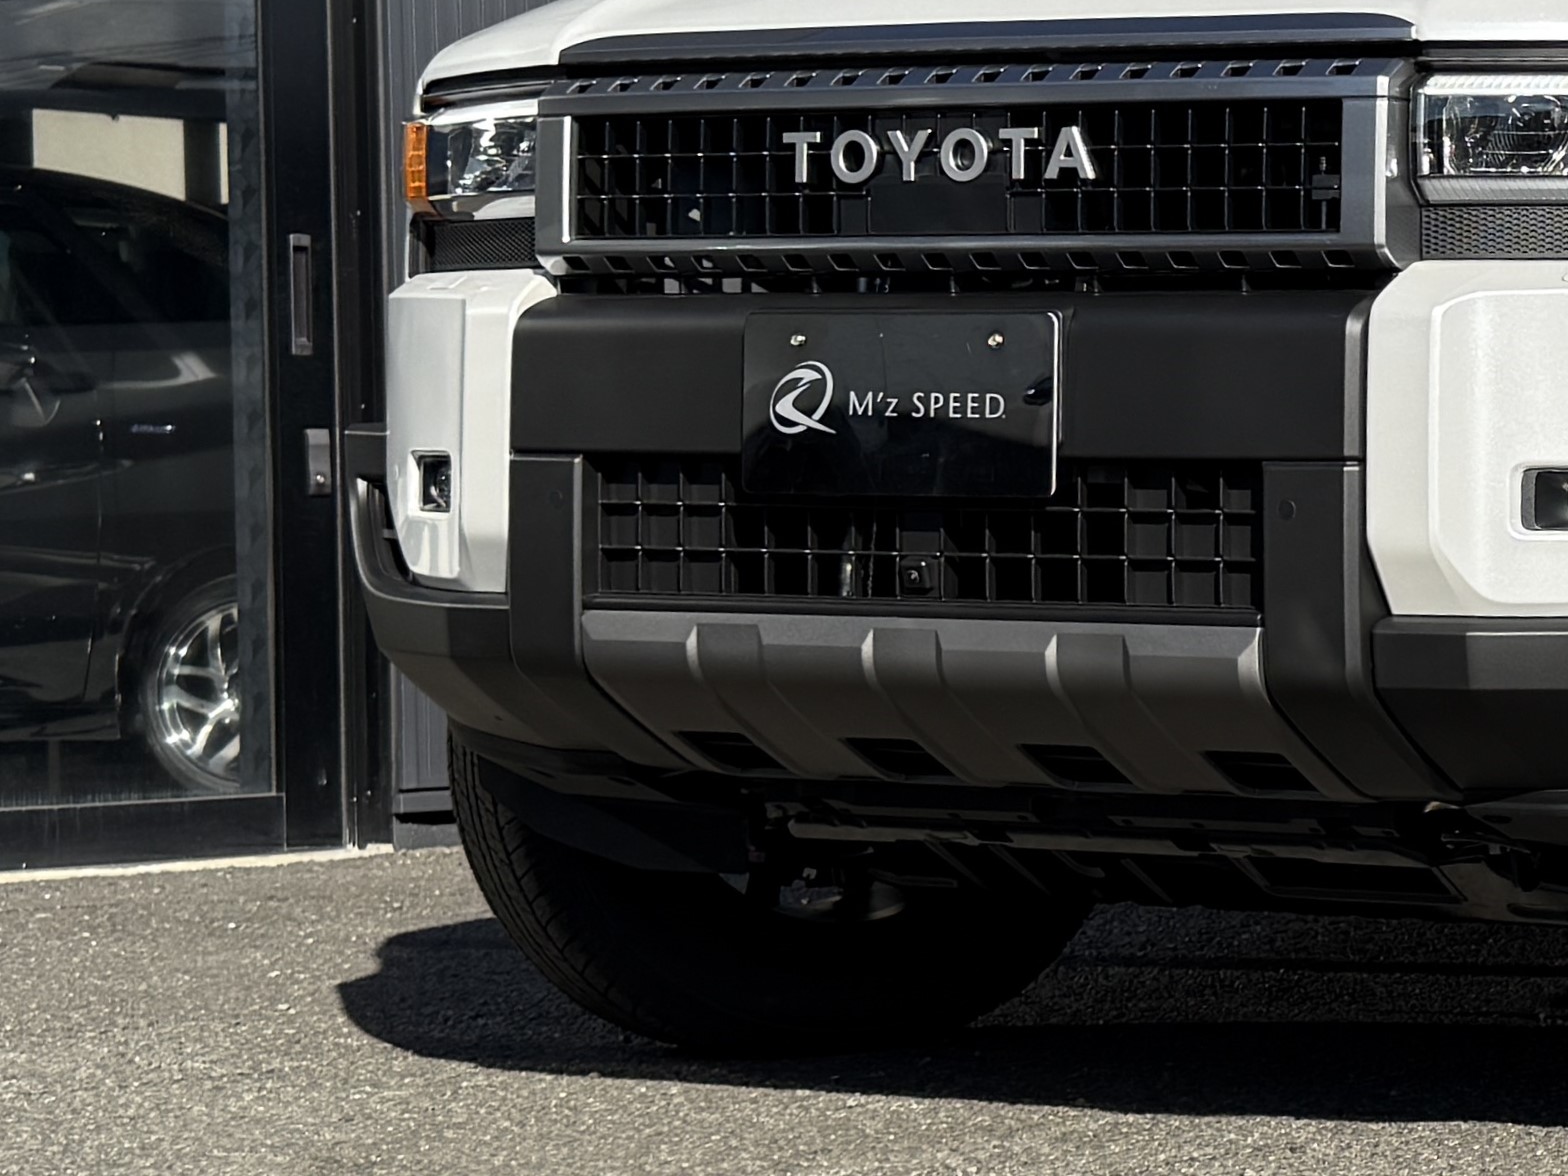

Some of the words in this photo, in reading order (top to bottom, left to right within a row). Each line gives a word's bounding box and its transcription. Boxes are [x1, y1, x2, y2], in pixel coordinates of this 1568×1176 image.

[782, 125, 1097, 184] TOYOTA
[848, 390, 899, 417] M'z
[911, 392, 1005, 419] SPEED
